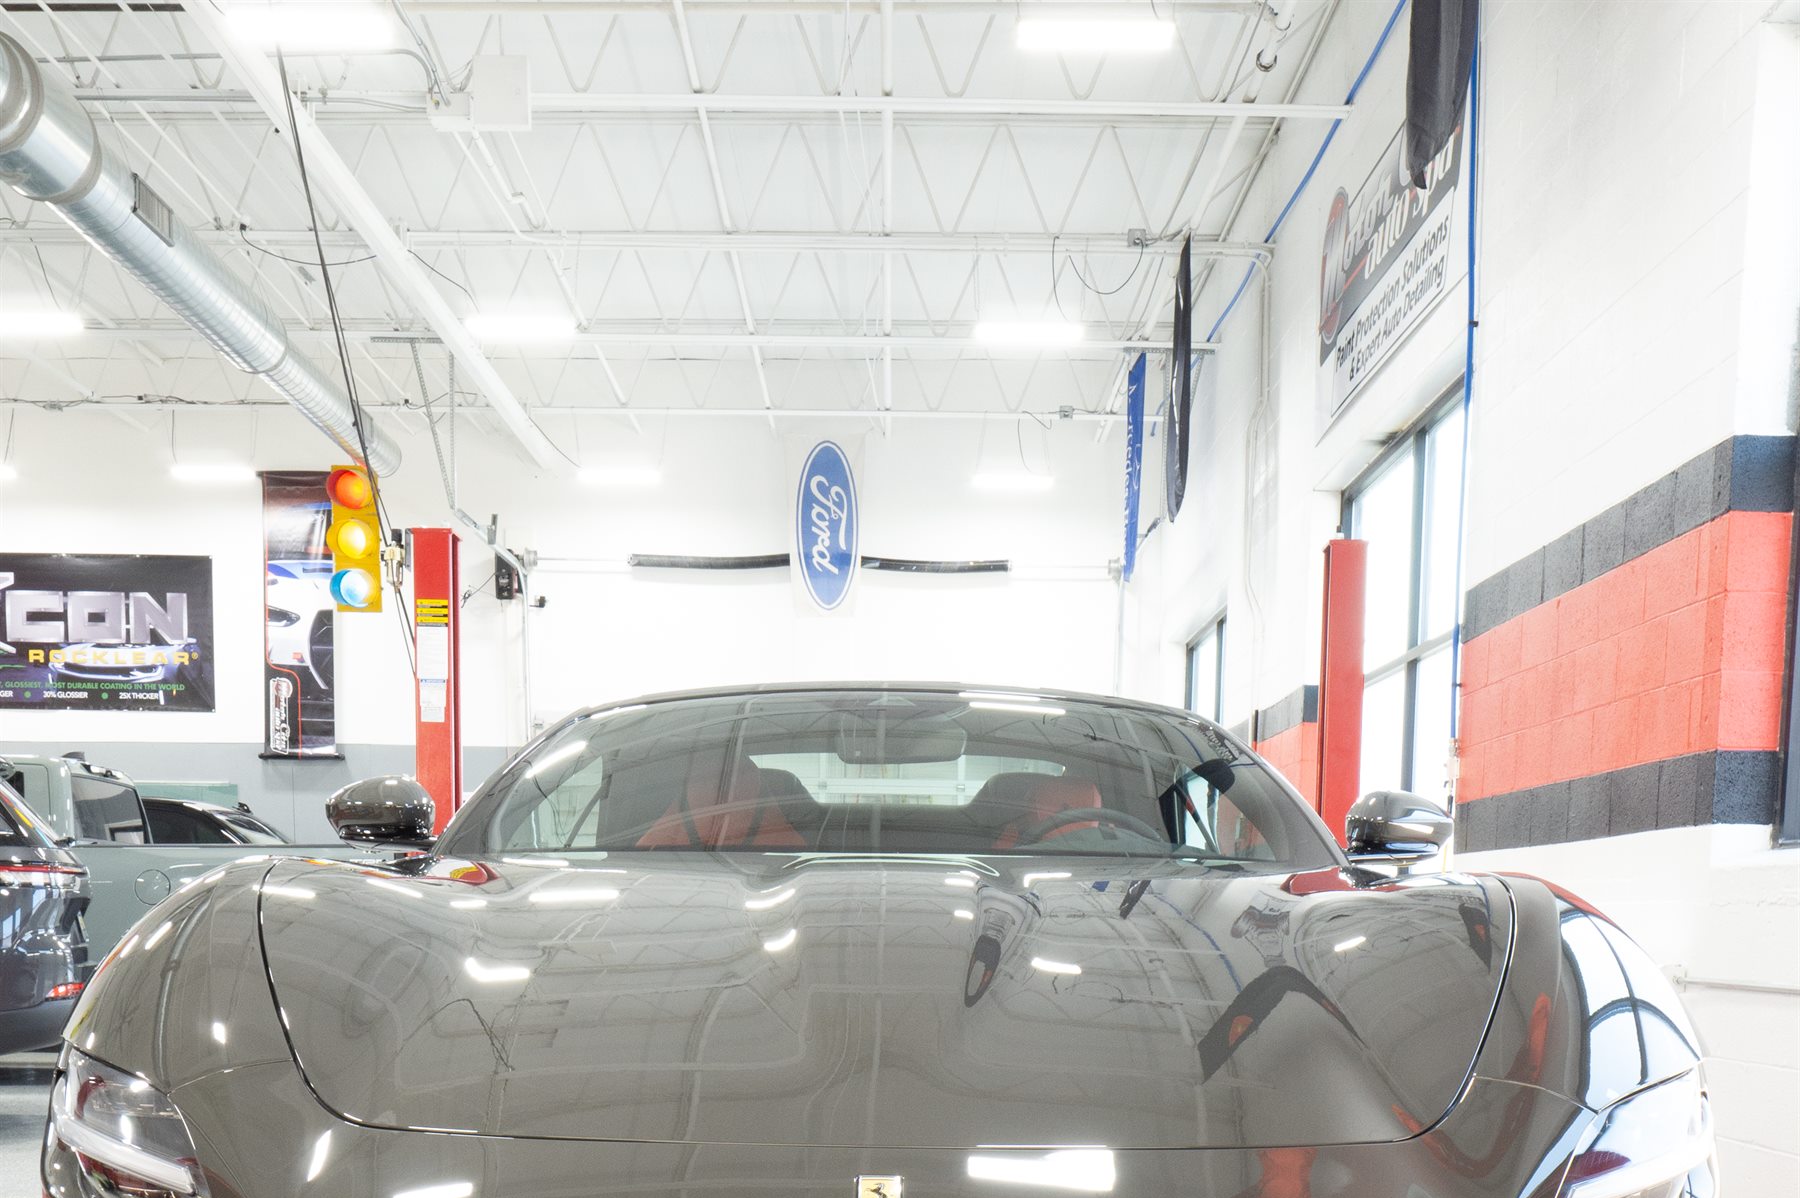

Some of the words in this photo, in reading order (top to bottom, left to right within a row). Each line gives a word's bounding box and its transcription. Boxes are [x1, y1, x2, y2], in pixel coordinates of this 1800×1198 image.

[1365, 189, 1410, 278] auto
[1336, 336, 1355, 371] Paint
[1356, 279, 1400, 342] Protection
[1401, 218, 1449, 277] Solutions
[1349, 363, 1355, 382] &
[1356, 334, 1381, 371] Expert
[1382, 308, 1401, 339] Auto
[1402, 254, 1444, 314] Detailing
[810, 474, 848, 577] Ford
[0, 572, 188, 654] CON
[57, 691, 88, 699] GLOSSIER
[67, 682, 98, 690] DURABLE
[100, 682, 132, 690] COATING
[158, 683, 185, 691] WORLD
[132, 692, 159, 700] THICKER
